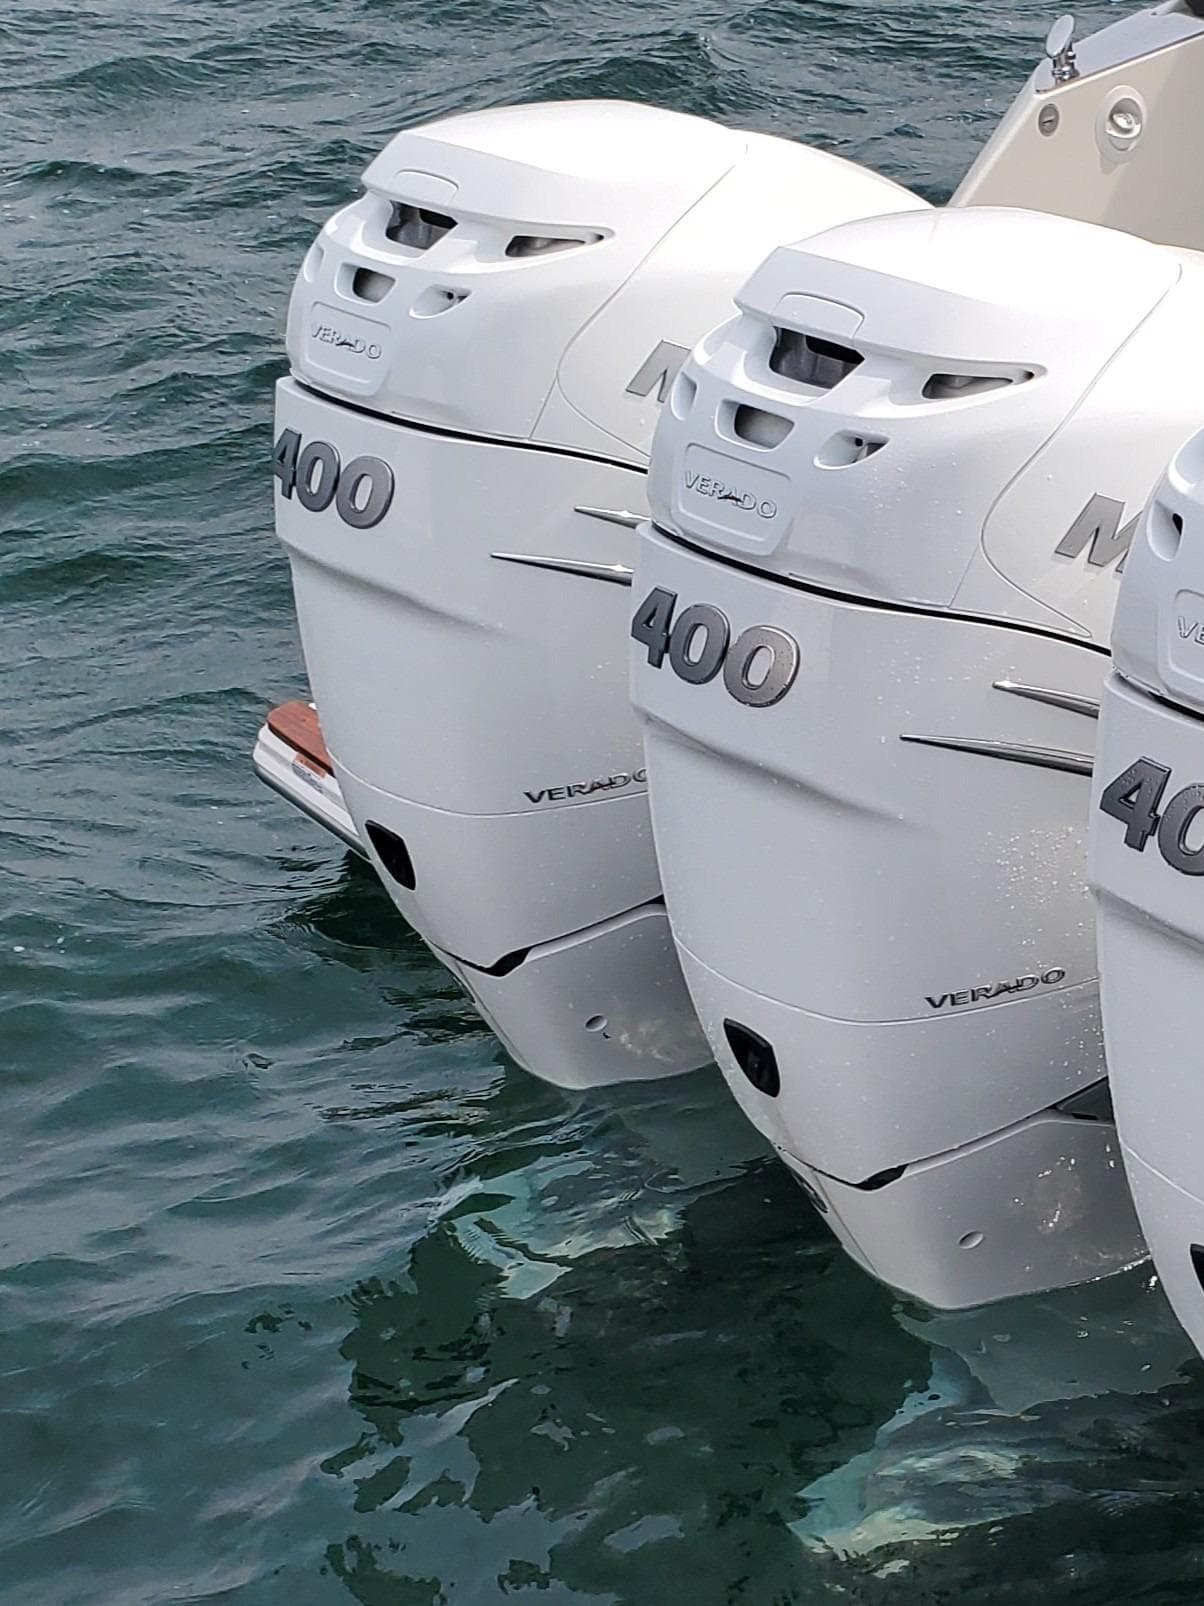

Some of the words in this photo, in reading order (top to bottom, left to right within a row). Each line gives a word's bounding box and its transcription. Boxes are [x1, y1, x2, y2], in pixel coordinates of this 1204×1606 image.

[273, 427, 396, 529] 400
[684, 471, 777, 519] VERADO
[631, 586, 801, 709] 400
[925, 966, 1066, 1008] VERADO
